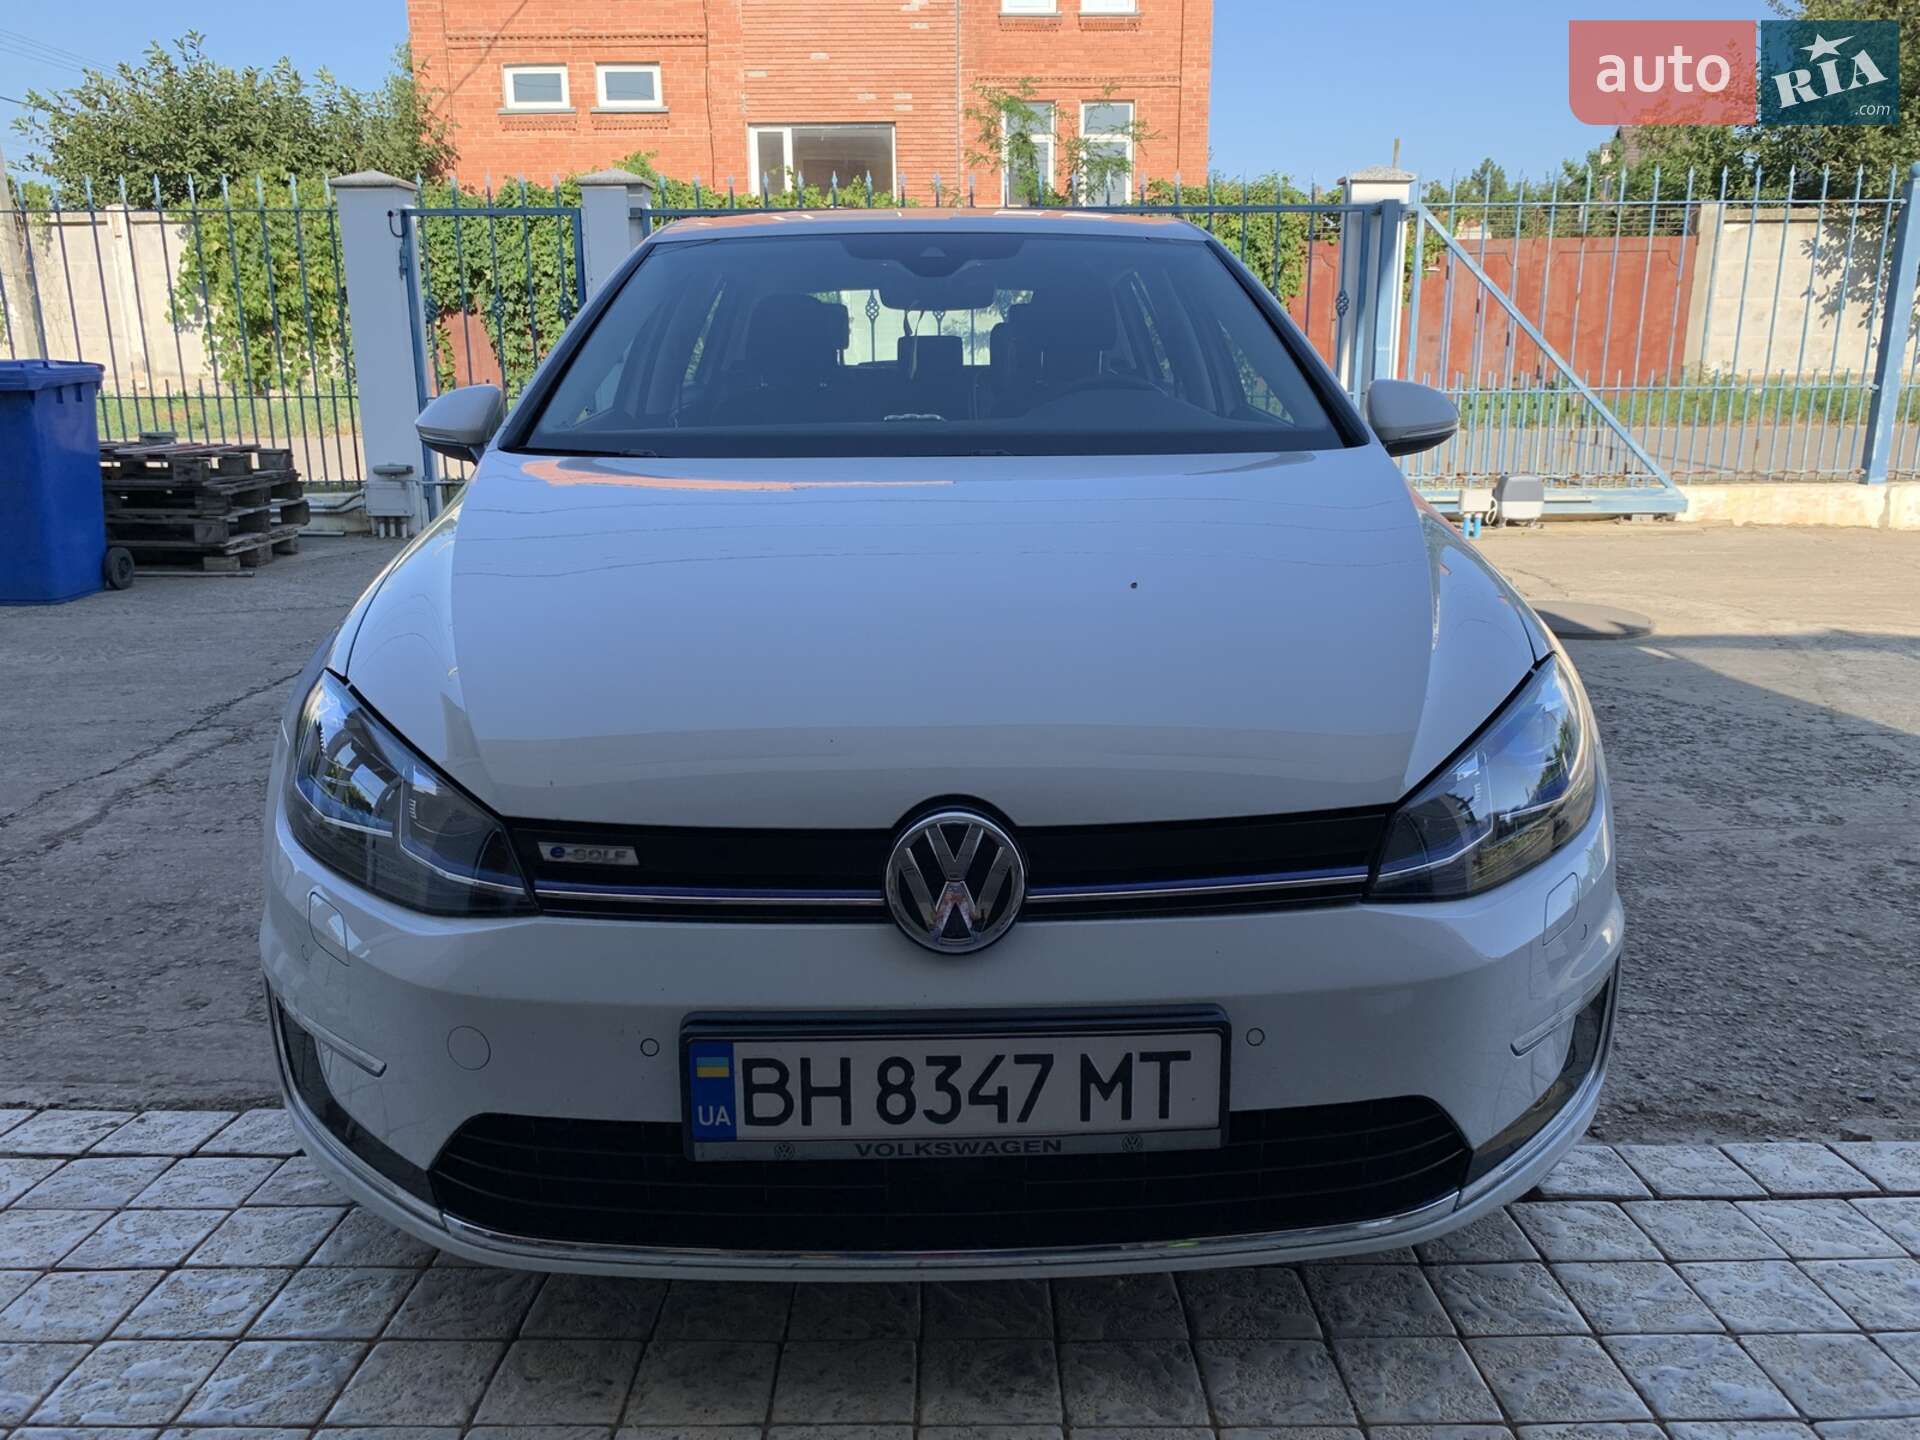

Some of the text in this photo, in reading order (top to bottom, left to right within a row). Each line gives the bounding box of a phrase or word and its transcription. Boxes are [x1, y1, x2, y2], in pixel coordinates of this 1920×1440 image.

[741, 1049, 1192, 1127] BH 8347 MT
[697, 1104, 732, 1127] UA
[854, 1138, 1063, 1159] VOLKSWAGEN
